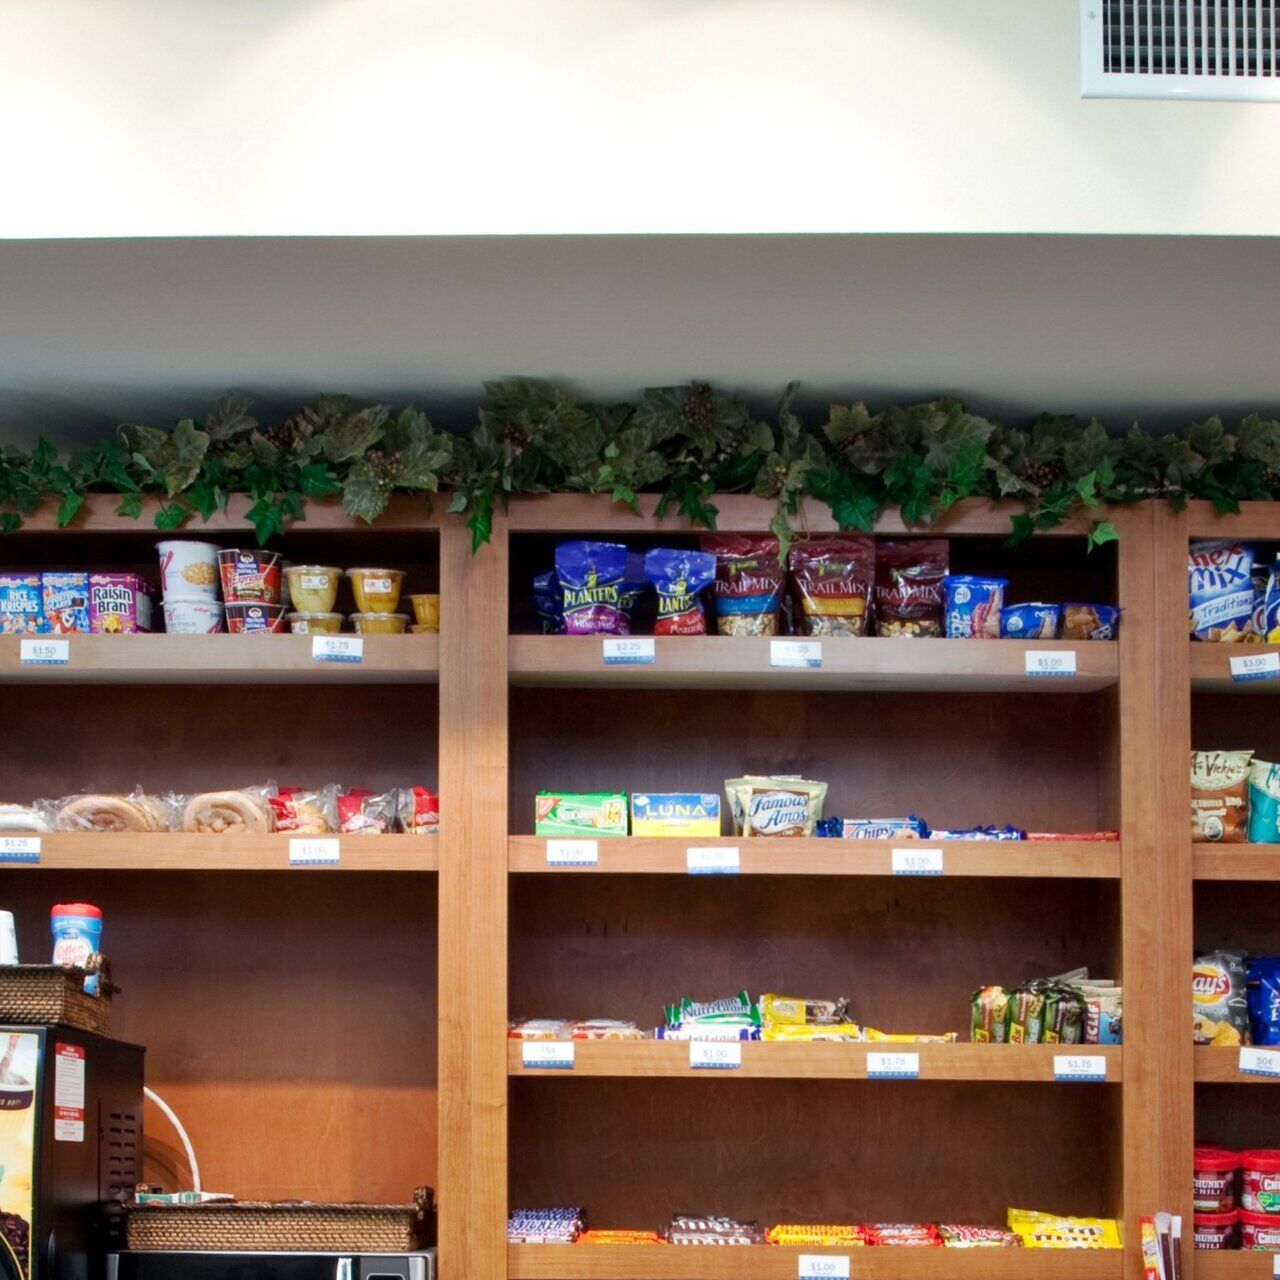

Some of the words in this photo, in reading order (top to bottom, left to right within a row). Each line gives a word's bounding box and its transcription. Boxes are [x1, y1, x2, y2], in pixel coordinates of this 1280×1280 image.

[751, 579, 780, 591] MIX
[801, 581, 838, 595] TRAIL
[840, 582, 866, 595] MIX
[9, 590, 28, 602] RICE
[93, 586, 131, 602] Raisin
[563, 585, 618, 608] PLANTERS
[911, 584, 939, 601] MIX
[1, 601, 39, 614] KRISPIES
[98, 600, 127, 614] Bran
[1037, 657, 1062, 667] $1.00
[1243, 658, 1266, 670] $3.00
[646, 803, 707, 817] LUNA
[749, 793, 809, 816] Famous
[760, 808, 809, 831] Amos
[1192, 972, 1229, 993] ays
[1067, 1060, 1092, 1069] $1.75
[1194, 1179, 1224, 1190] HUNKY
[1194, 1233, 1224, 1244] HUNKY
